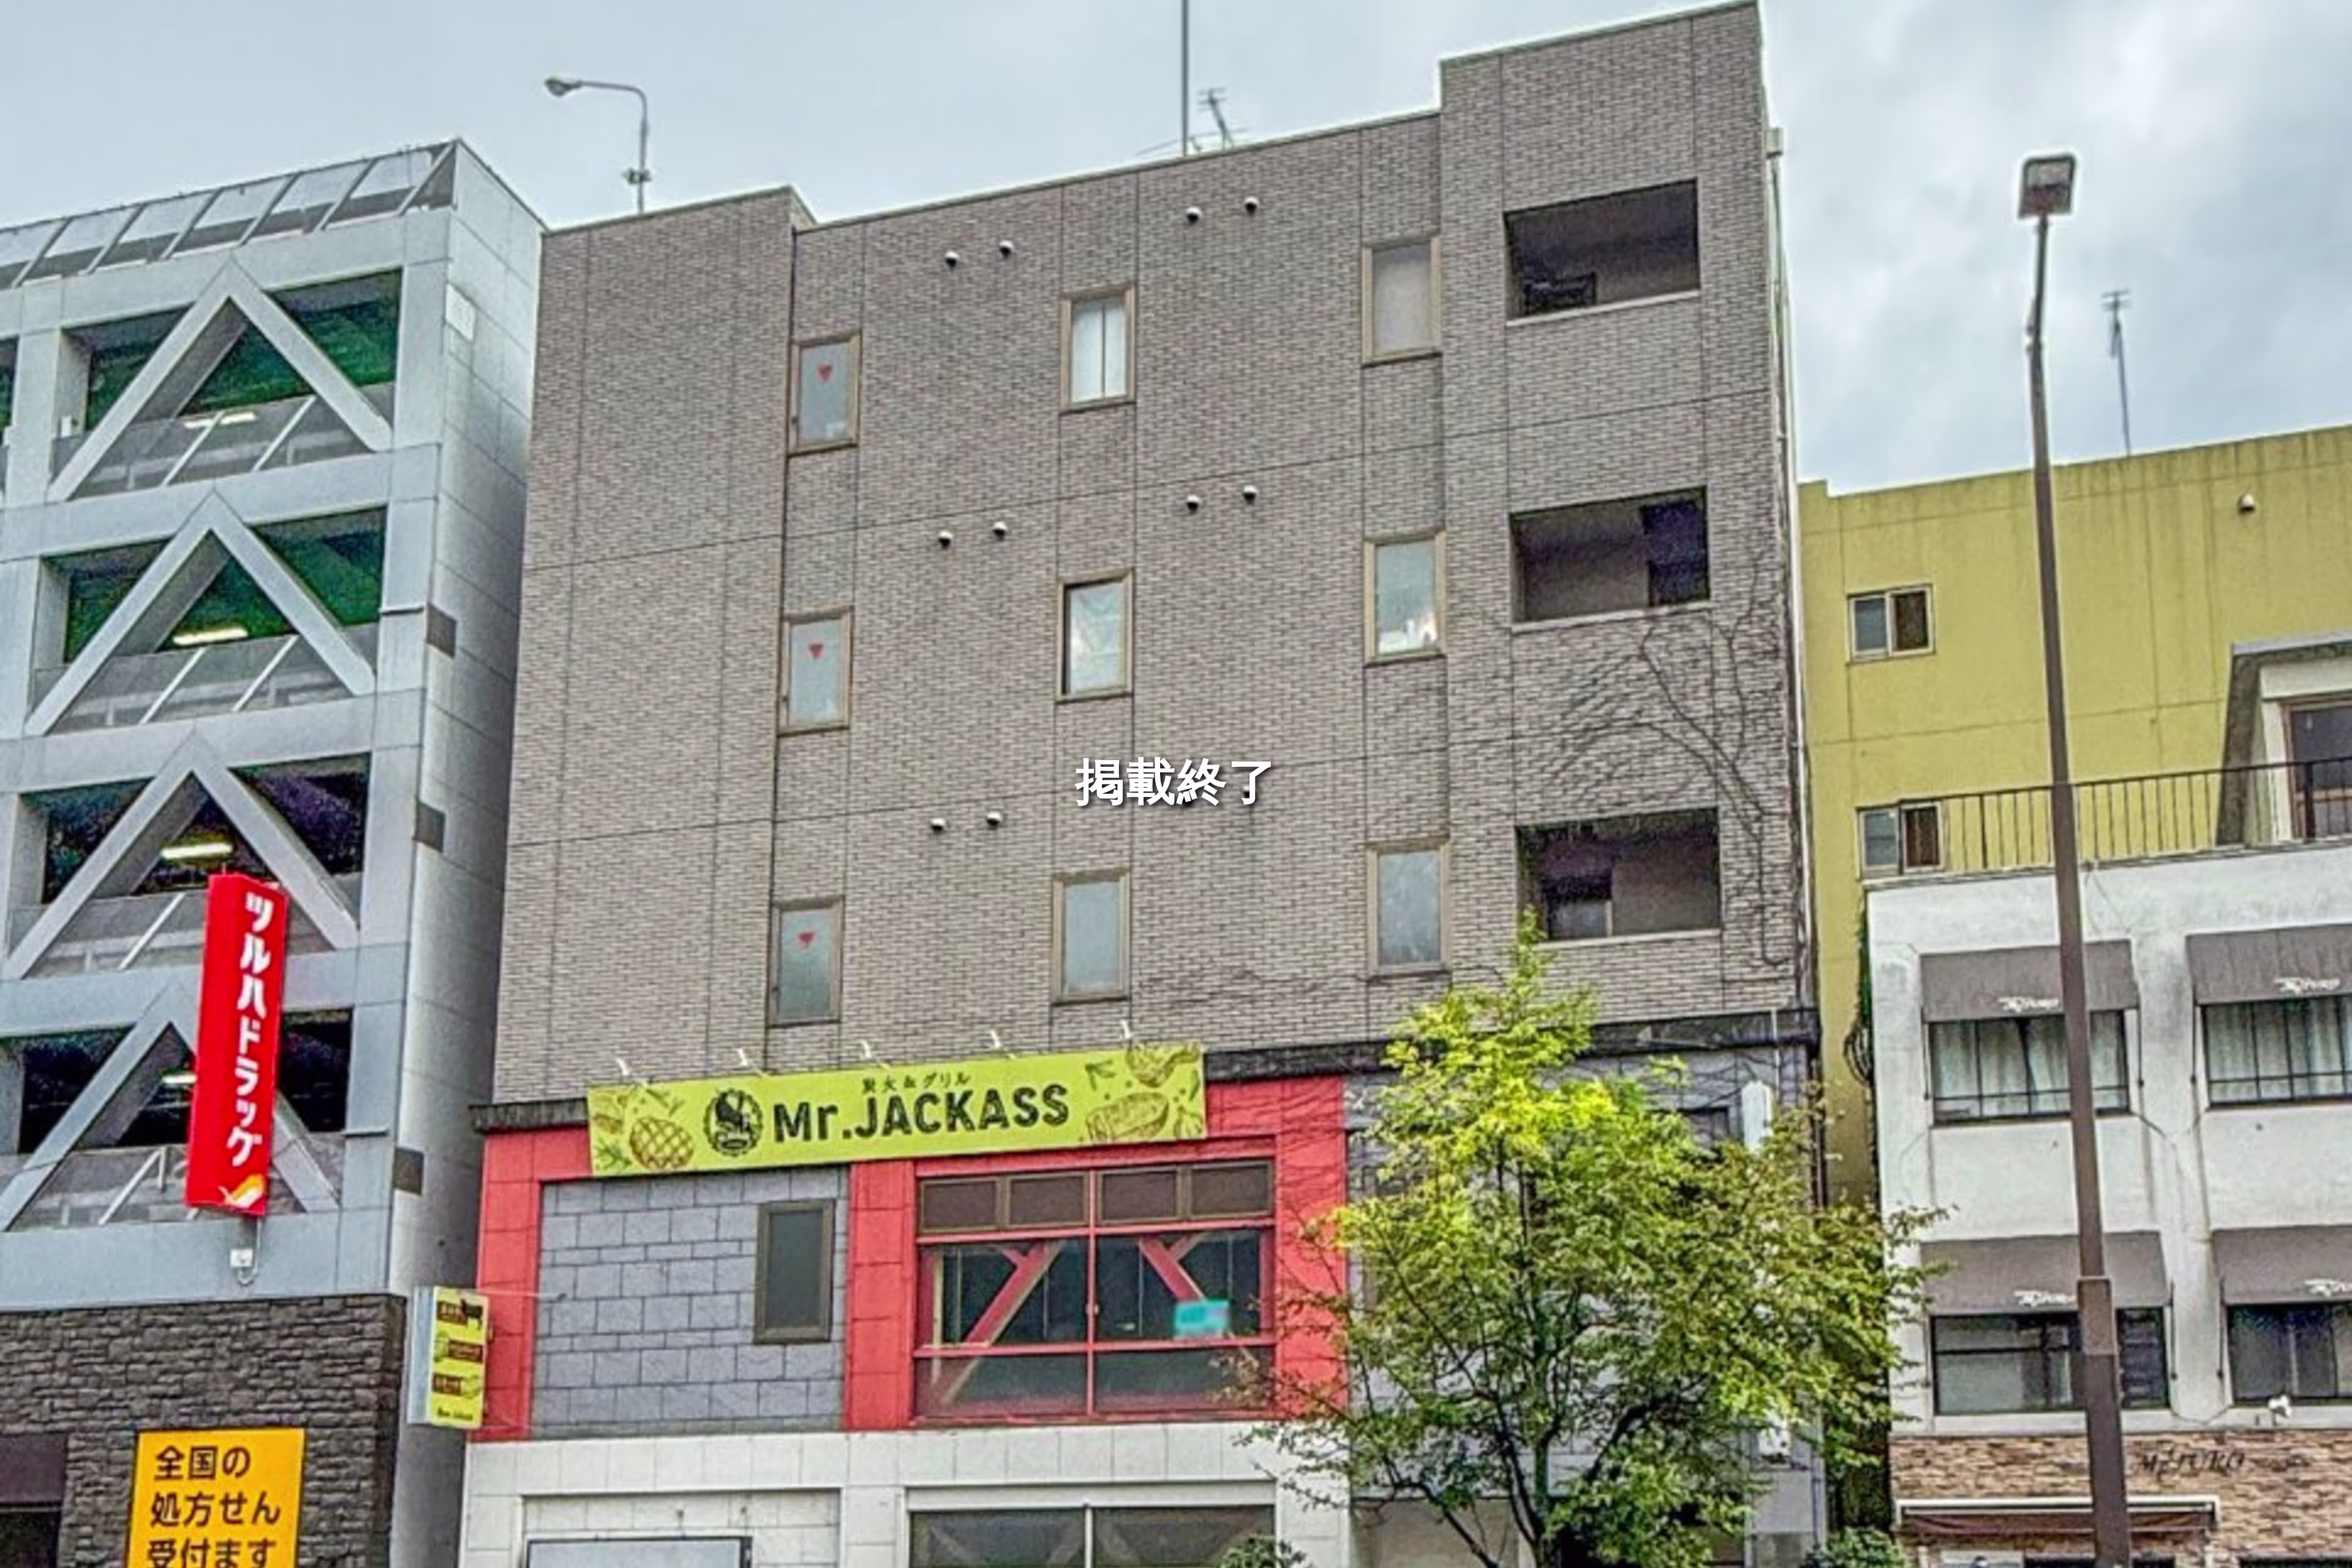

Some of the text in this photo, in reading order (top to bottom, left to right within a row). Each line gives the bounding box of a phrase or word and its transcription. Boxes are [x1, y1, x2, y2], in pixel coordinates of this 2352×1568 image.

[226, 892, 274, 1167] ツルハドラッグ
[774, 1084, 1069, 1143] Mr.JACKASS
[153, 1446, 251, 1480] 全国の
[151, 1491, 281, 1528] 処方せん
[147, 1538, 277, 1568] 受付ます
